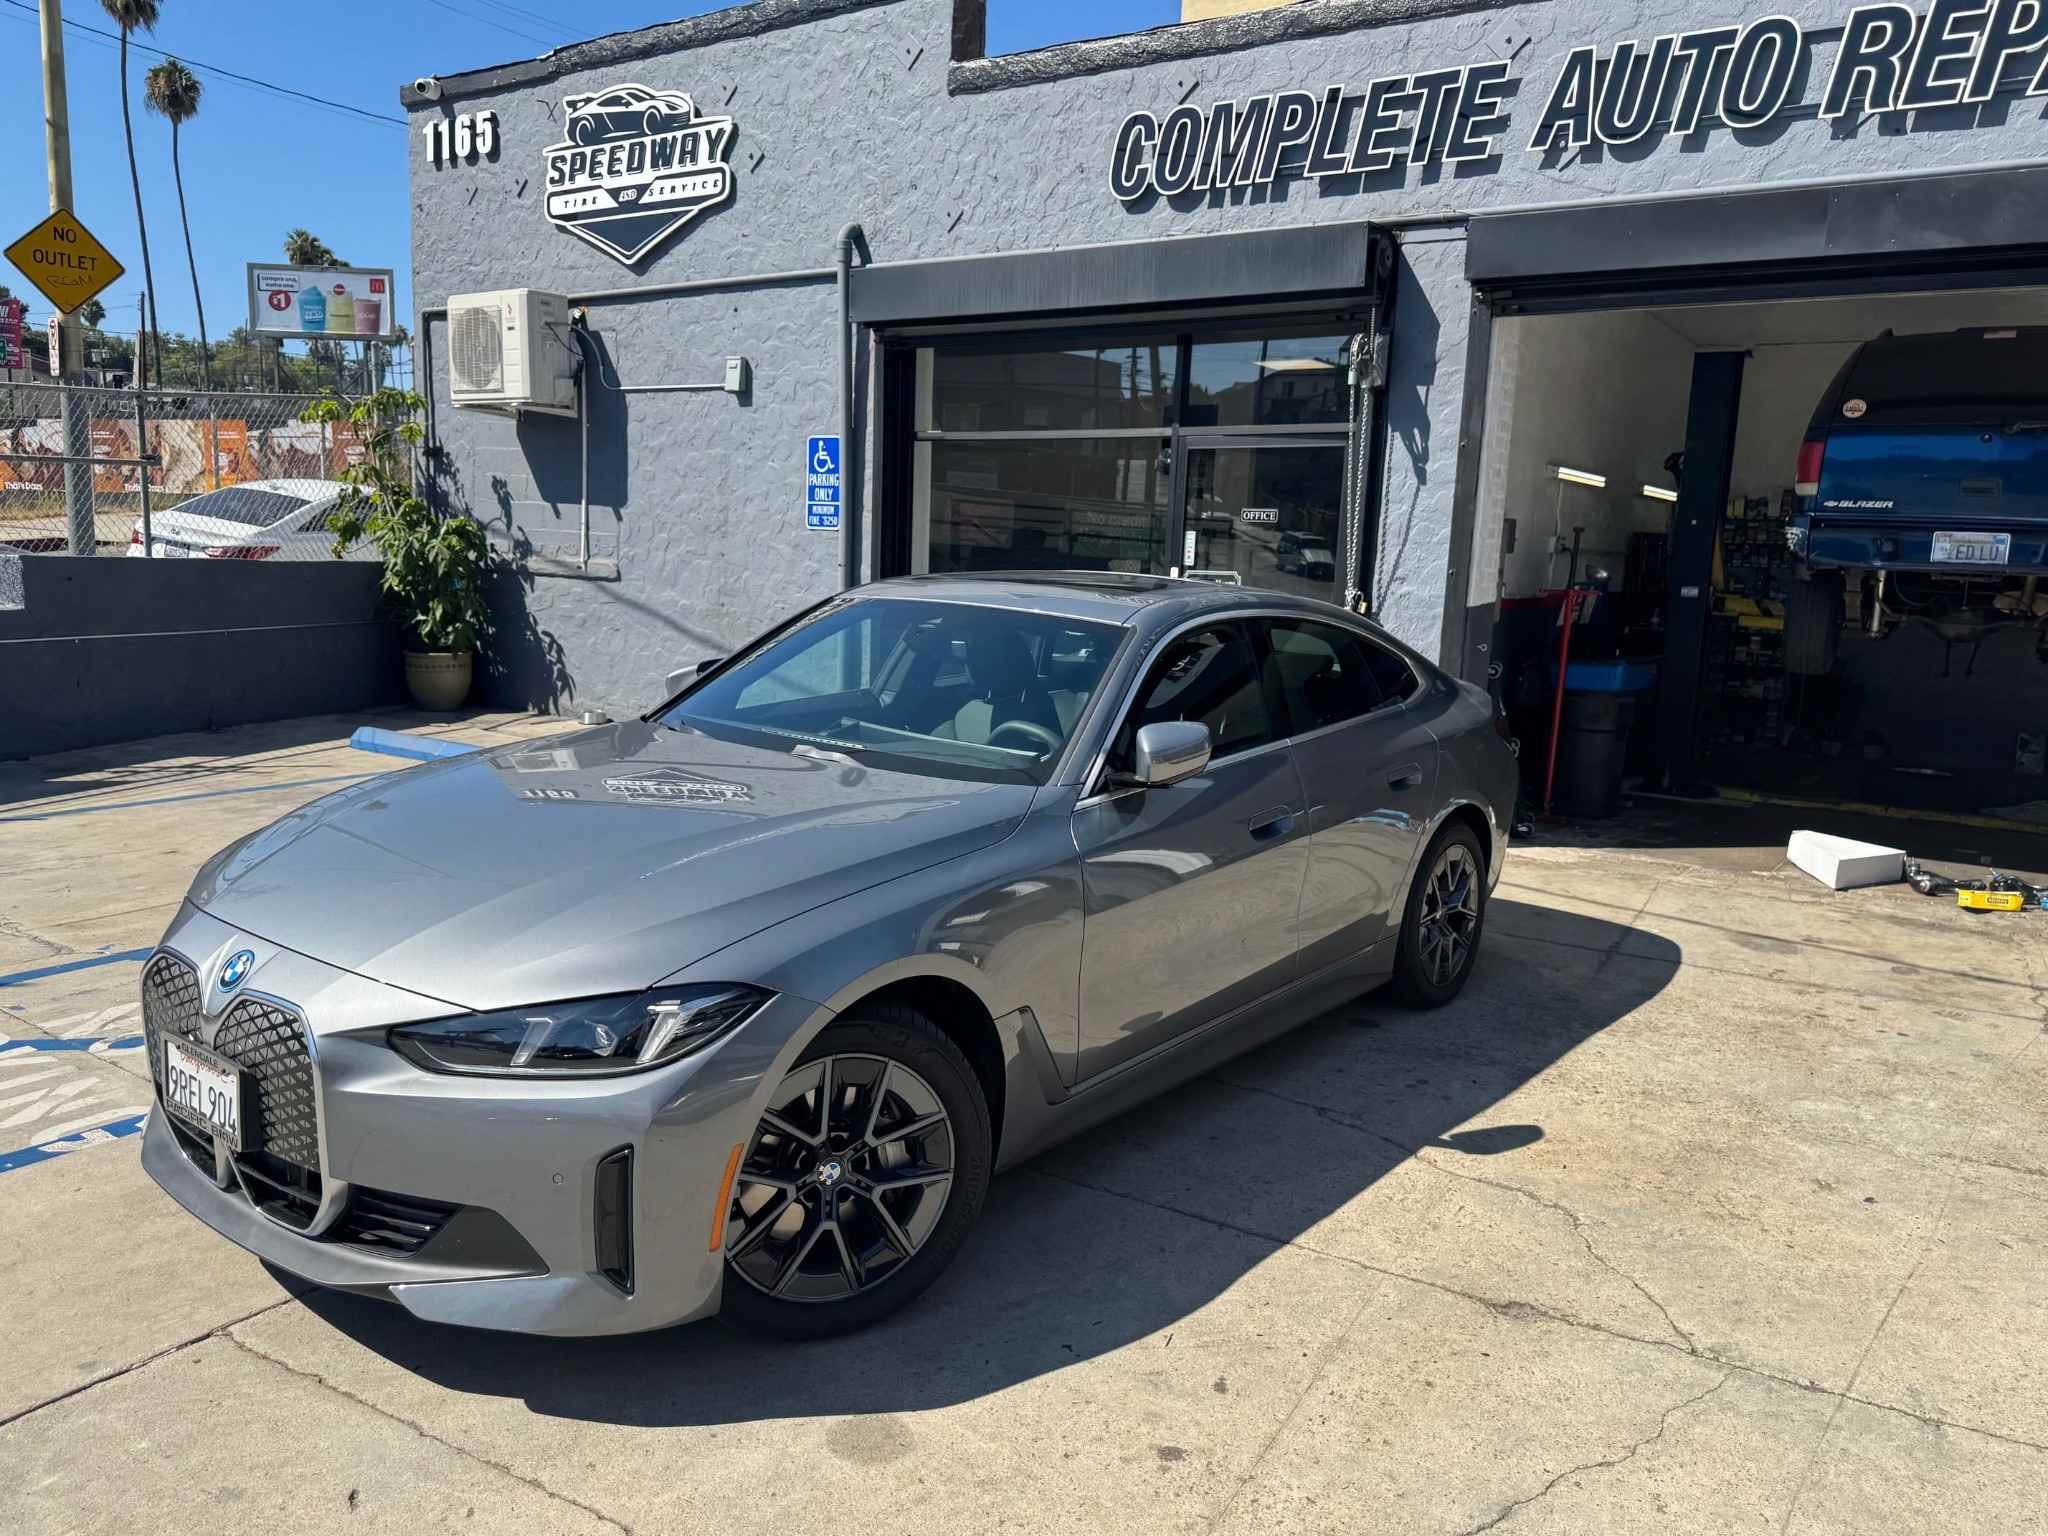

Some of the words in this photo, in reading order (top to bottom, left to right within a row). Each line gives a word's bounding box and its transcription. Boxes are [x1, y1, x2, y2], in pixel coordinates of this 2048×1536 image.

[1108, 60, 1511, 201] COMPLETE
[1529, 15, 1801, 151] AUTO
[1818, 0, 2048, 119] REP
[423, 109, 493, 162] 1165
[549, 127, 726, 187] SPEEDWAY
[563, 195, 598, 209] TIRE
[620, 190, 637, 200] AND
[648, 178, 720, 198] SERVICE
[53, 226, 77, 243] NO
[32, 249, 97, 271] OUTLET
[809, 473, 839, 486] PARKING
[814, 487, 833, 501] ONLY
[1838, 500, 1894, 508] BLAZER
[1243, 511, 1276, 520] OFFICE
[170, 1065, 207, 1119] 9REL
[208, 1086, 237, 1134] 904
[166, 1098, 207, 1130] PACIFIC
